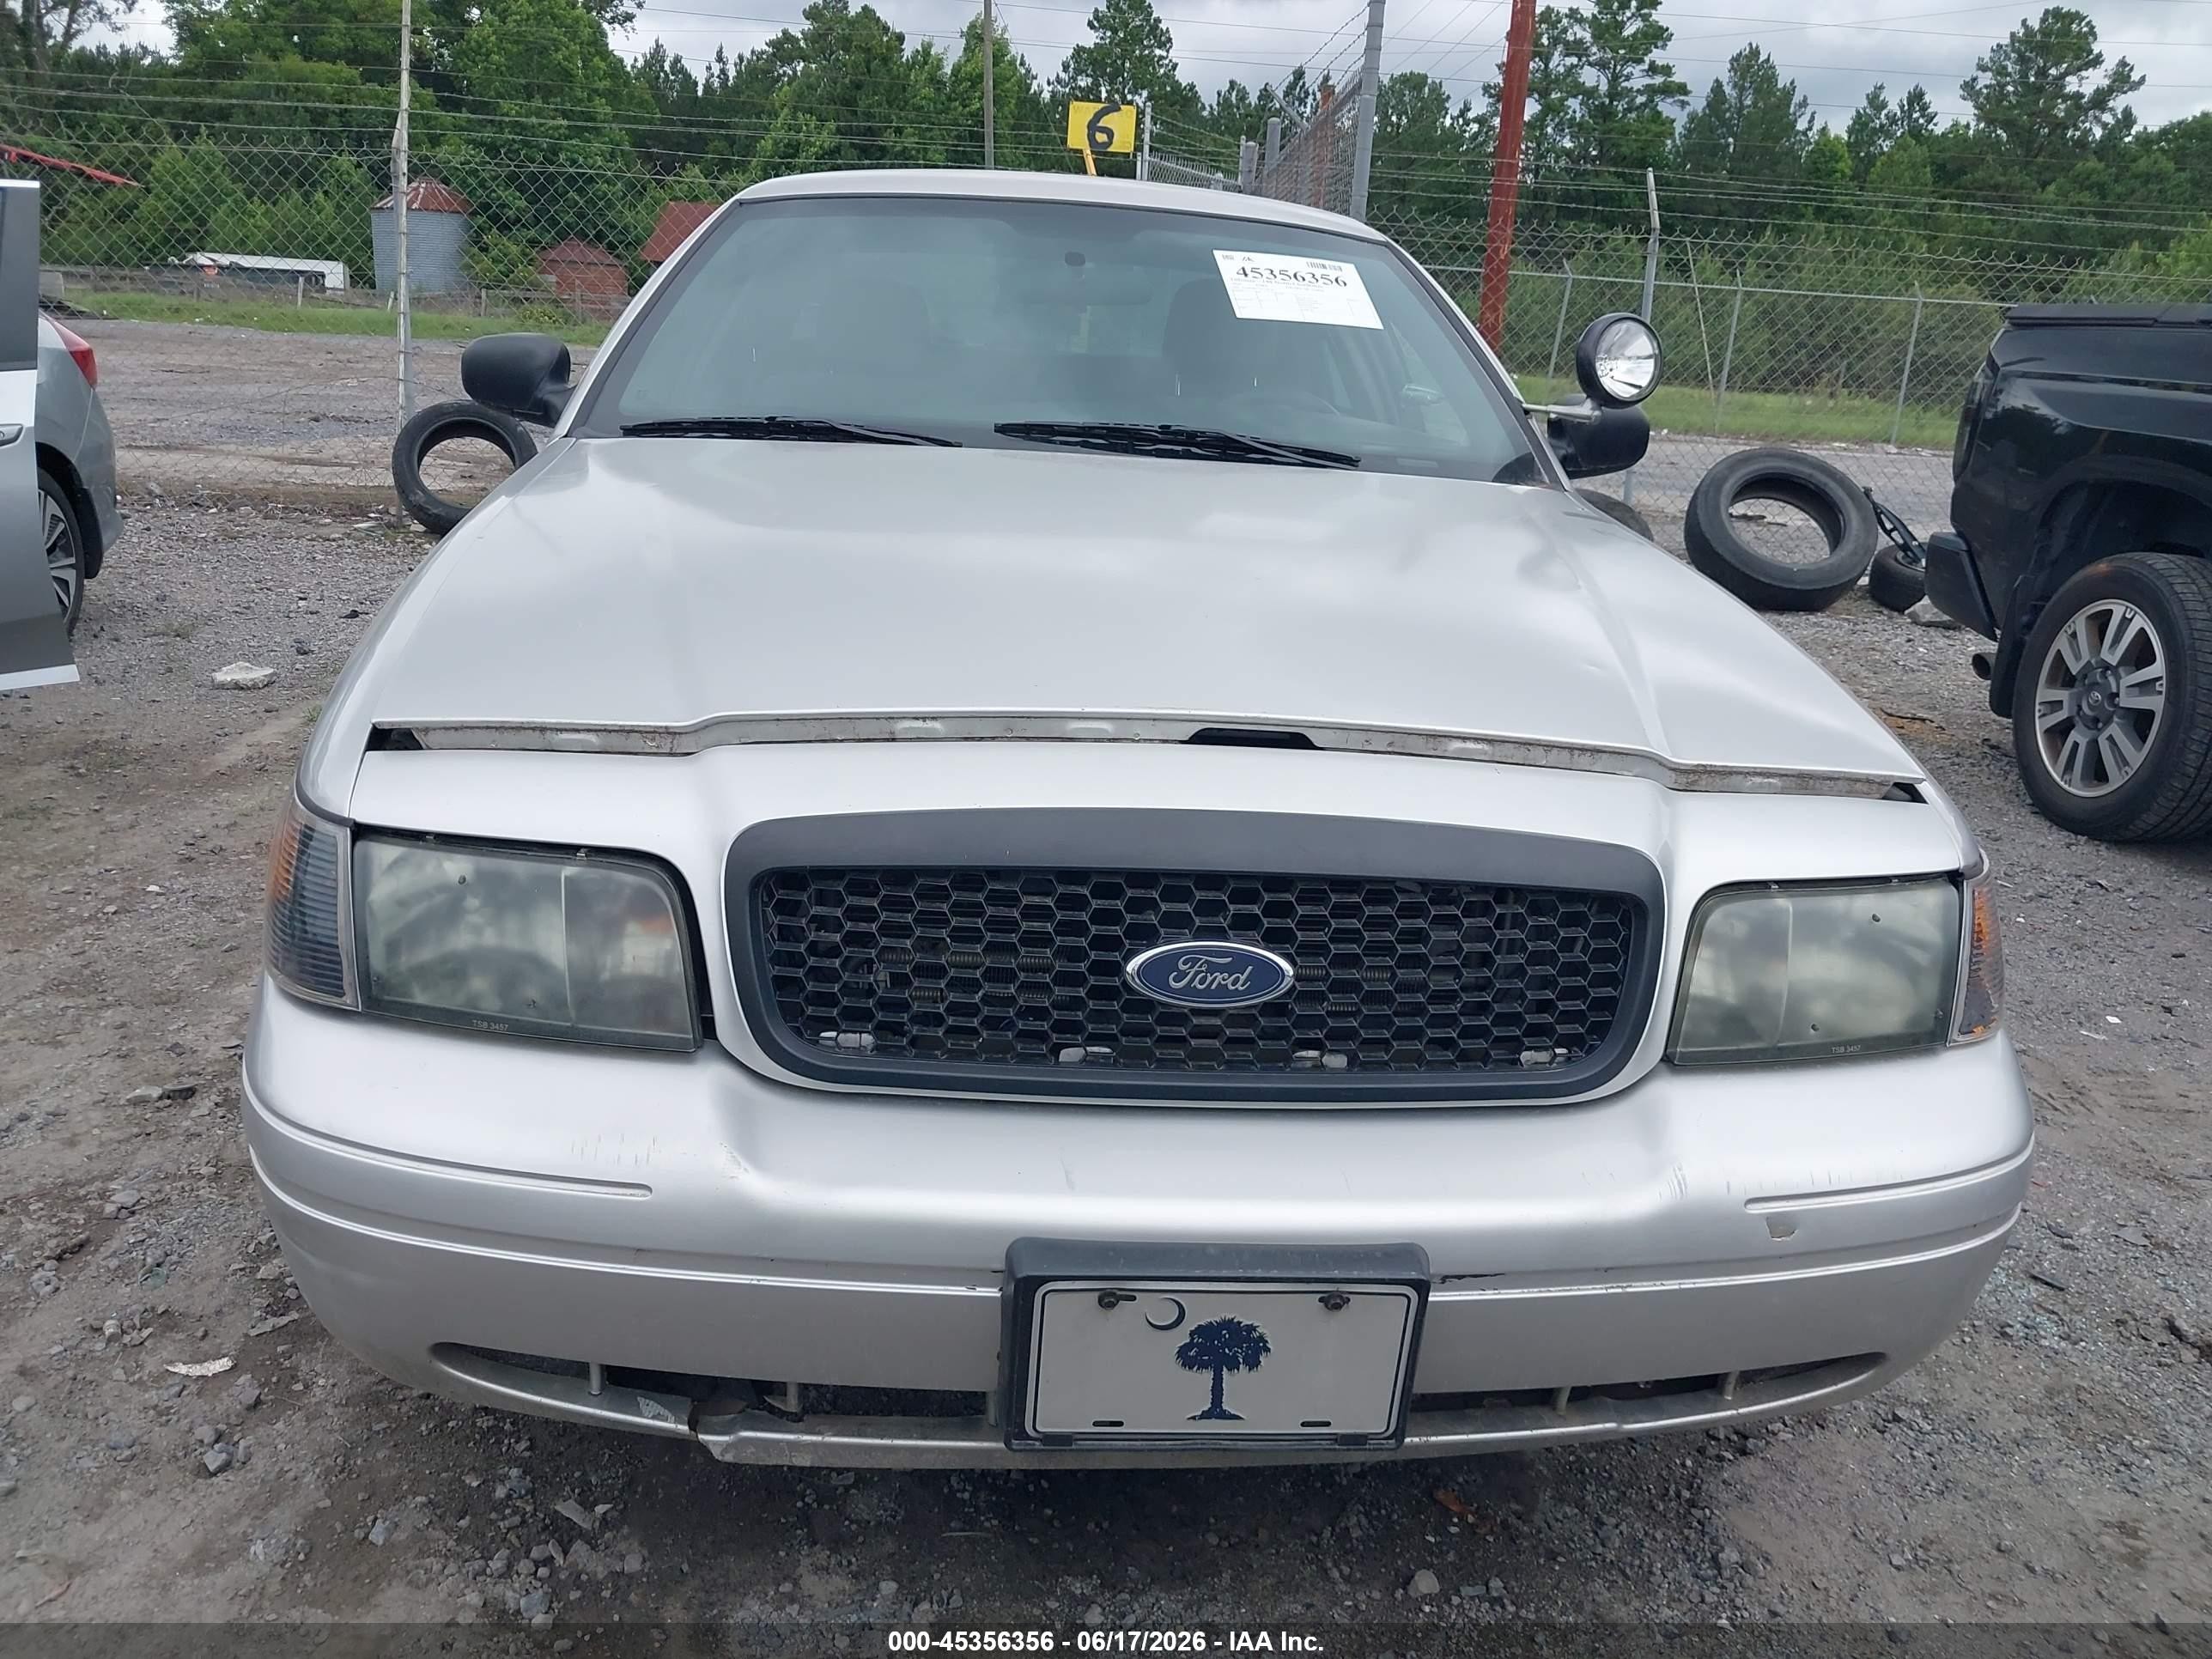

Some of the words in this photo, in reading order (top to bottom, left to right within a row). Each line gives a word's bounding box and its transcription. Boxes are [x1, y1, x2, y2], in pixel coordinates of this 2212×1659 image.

[1087, 103, 1121, 151] 6
[1237, 265, 1347, 288] 45356356
[1169, 954, 1253, 991] Ford
